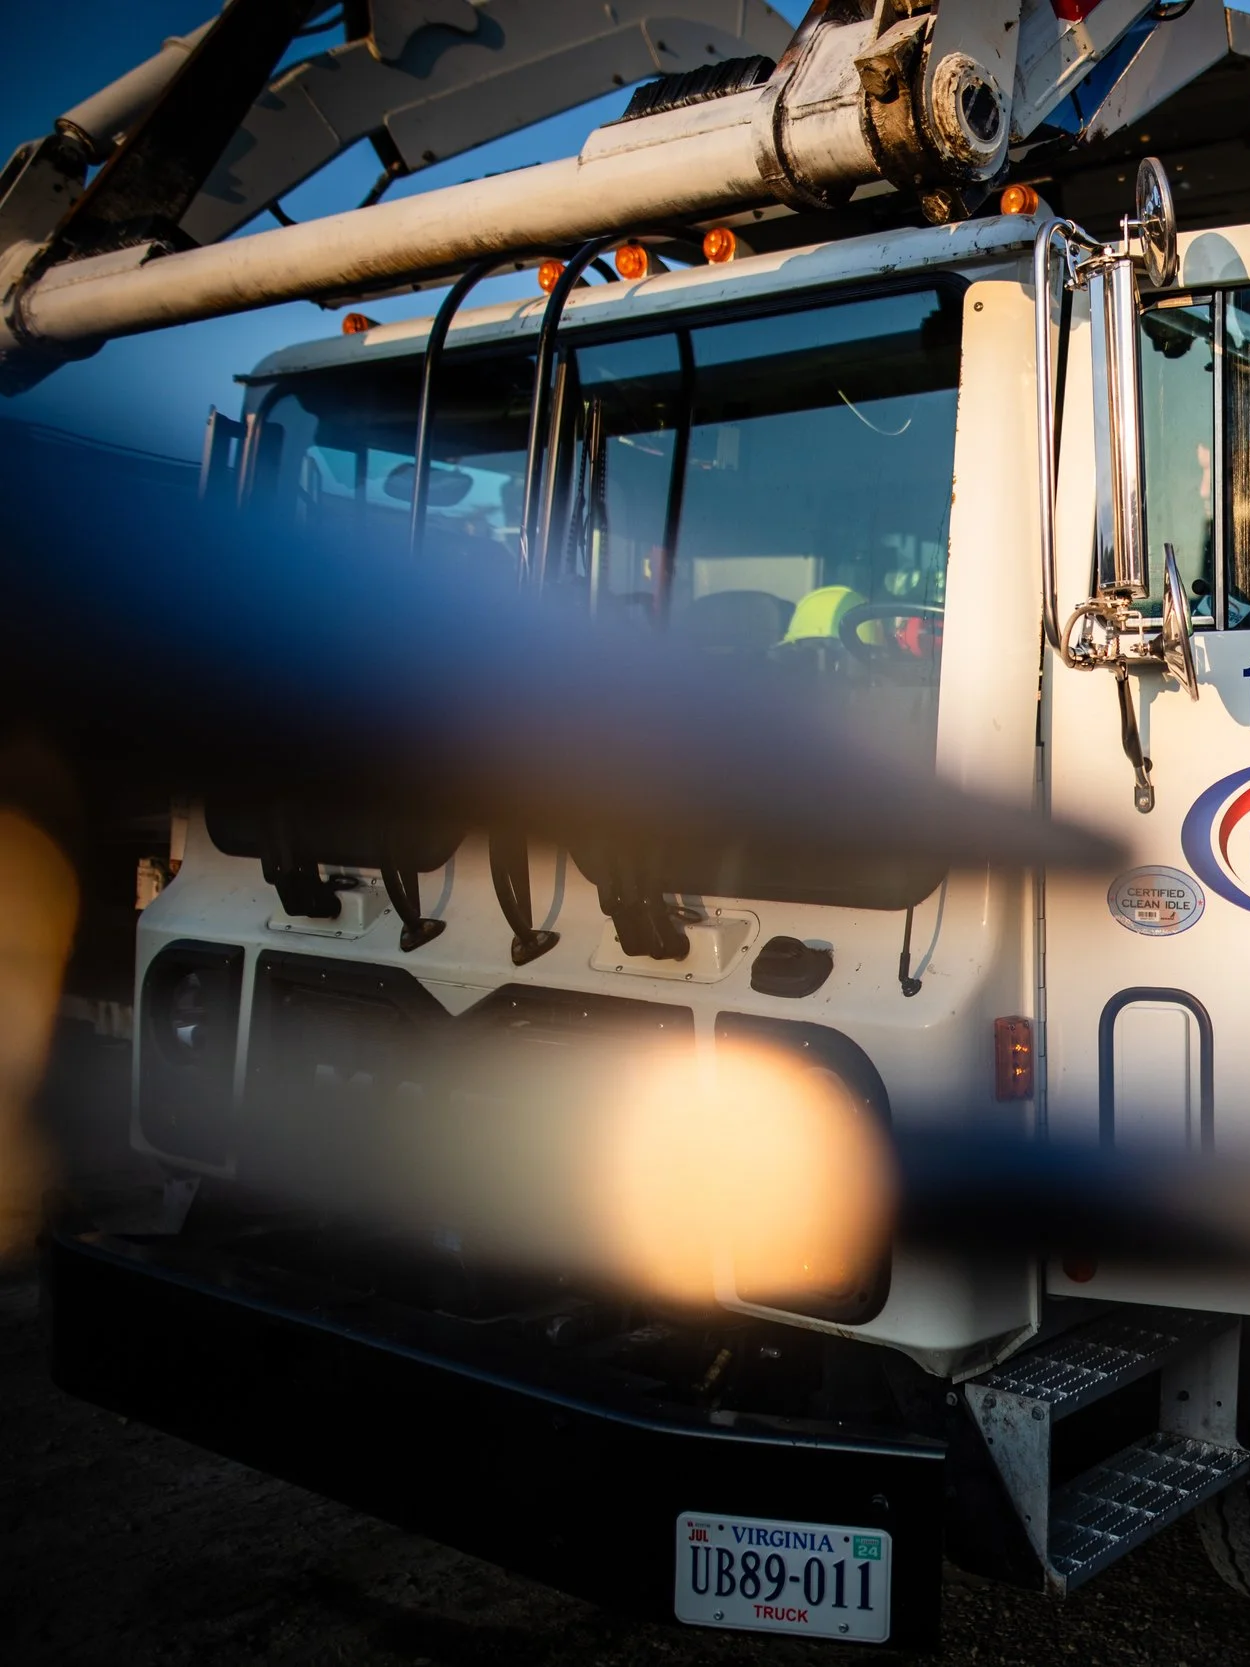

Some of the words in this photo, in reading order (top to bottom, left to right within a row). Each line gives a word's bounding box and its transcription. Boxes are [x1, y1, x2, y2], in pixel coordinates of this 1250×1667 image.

[1127, 888, 1185, 898] CERTIFIED
[1121, 899, 1160, 909] CLEAN
[1165, 901, 1191, 910] IDLE
[688, 1528, 709, 1543] JUL
[731, 1525, 835, 1553] VIRGINIA
[857, 1544, 879, 1558] 24
[690, 1545, 873, 1611] UB89-011
[753, 1604, 809, 1624] TRUCK
